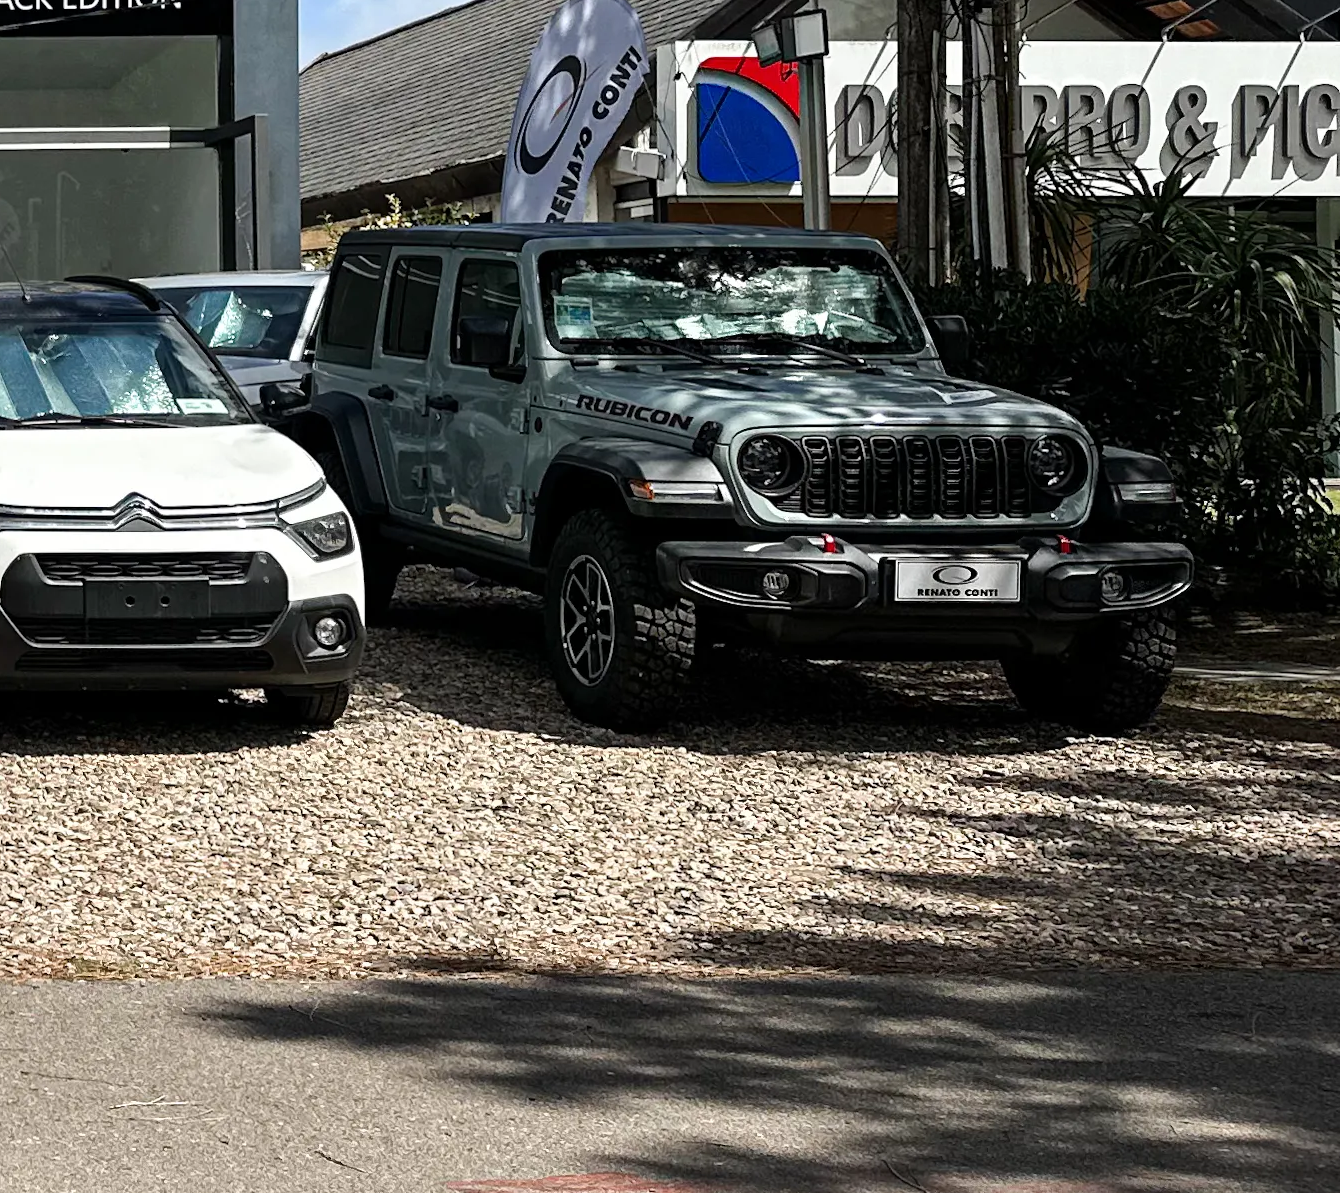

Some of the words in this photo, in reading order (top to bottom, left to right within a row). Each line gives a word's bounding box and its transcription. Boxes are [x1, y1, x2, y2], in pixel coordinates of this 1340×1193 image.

[592, 45, 643, 120] CONTI
[1234, 83, 1340, 162] PIC
[575, 394, 694, 431] RUBICON
[917, 588, 961, 597] RENATO
[964, 588, 998, 597] CONTI
